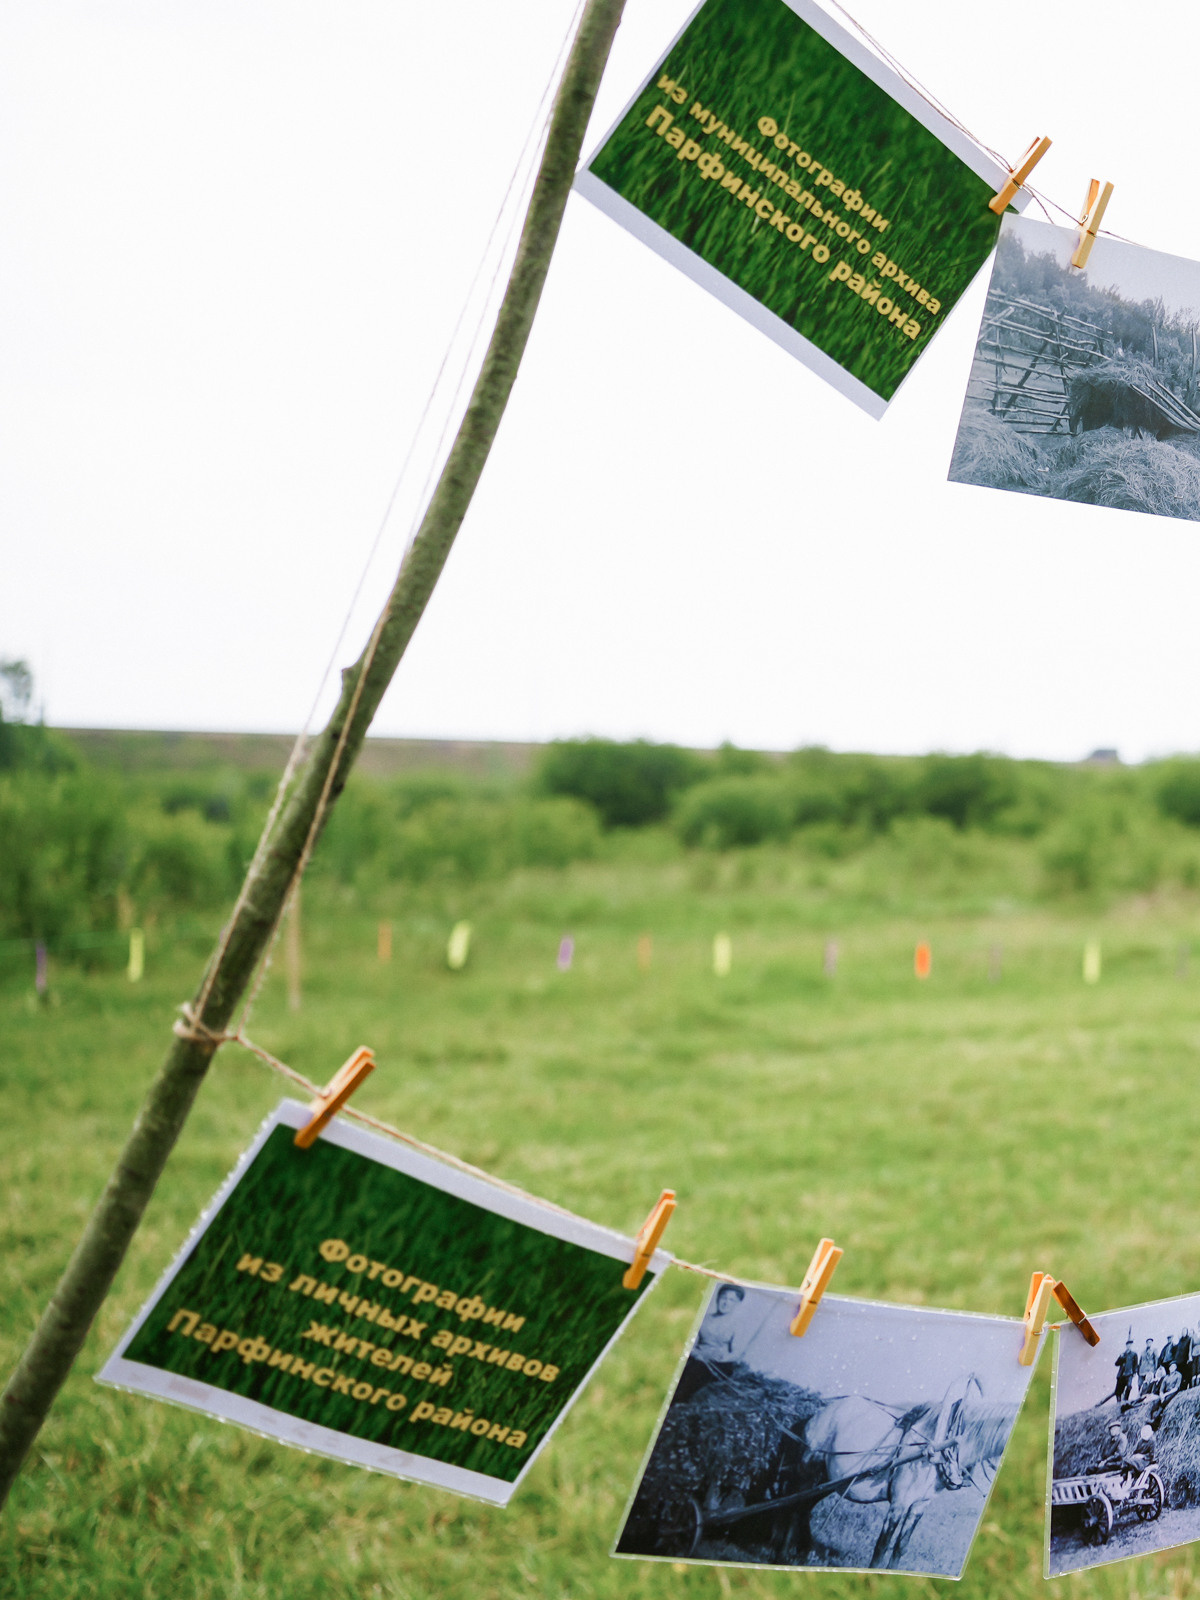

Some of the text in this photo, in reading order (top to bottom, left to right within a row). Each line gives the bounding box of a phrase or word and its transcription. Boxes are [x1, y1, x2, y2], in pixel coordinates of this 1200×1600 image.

[644, 104, 923, 340] Парфинского района
[656, 74, 942, 315] из муниципального архива
[757, 116, 890, 233] Фотографии
[235, 1253, 561, 1383] из личных архивов
[318, 1238, 526, 1333] Фотографии
[166, 1308, 529, 1449] Парфинского района
[302, 1320, 454, 1387] жителей
